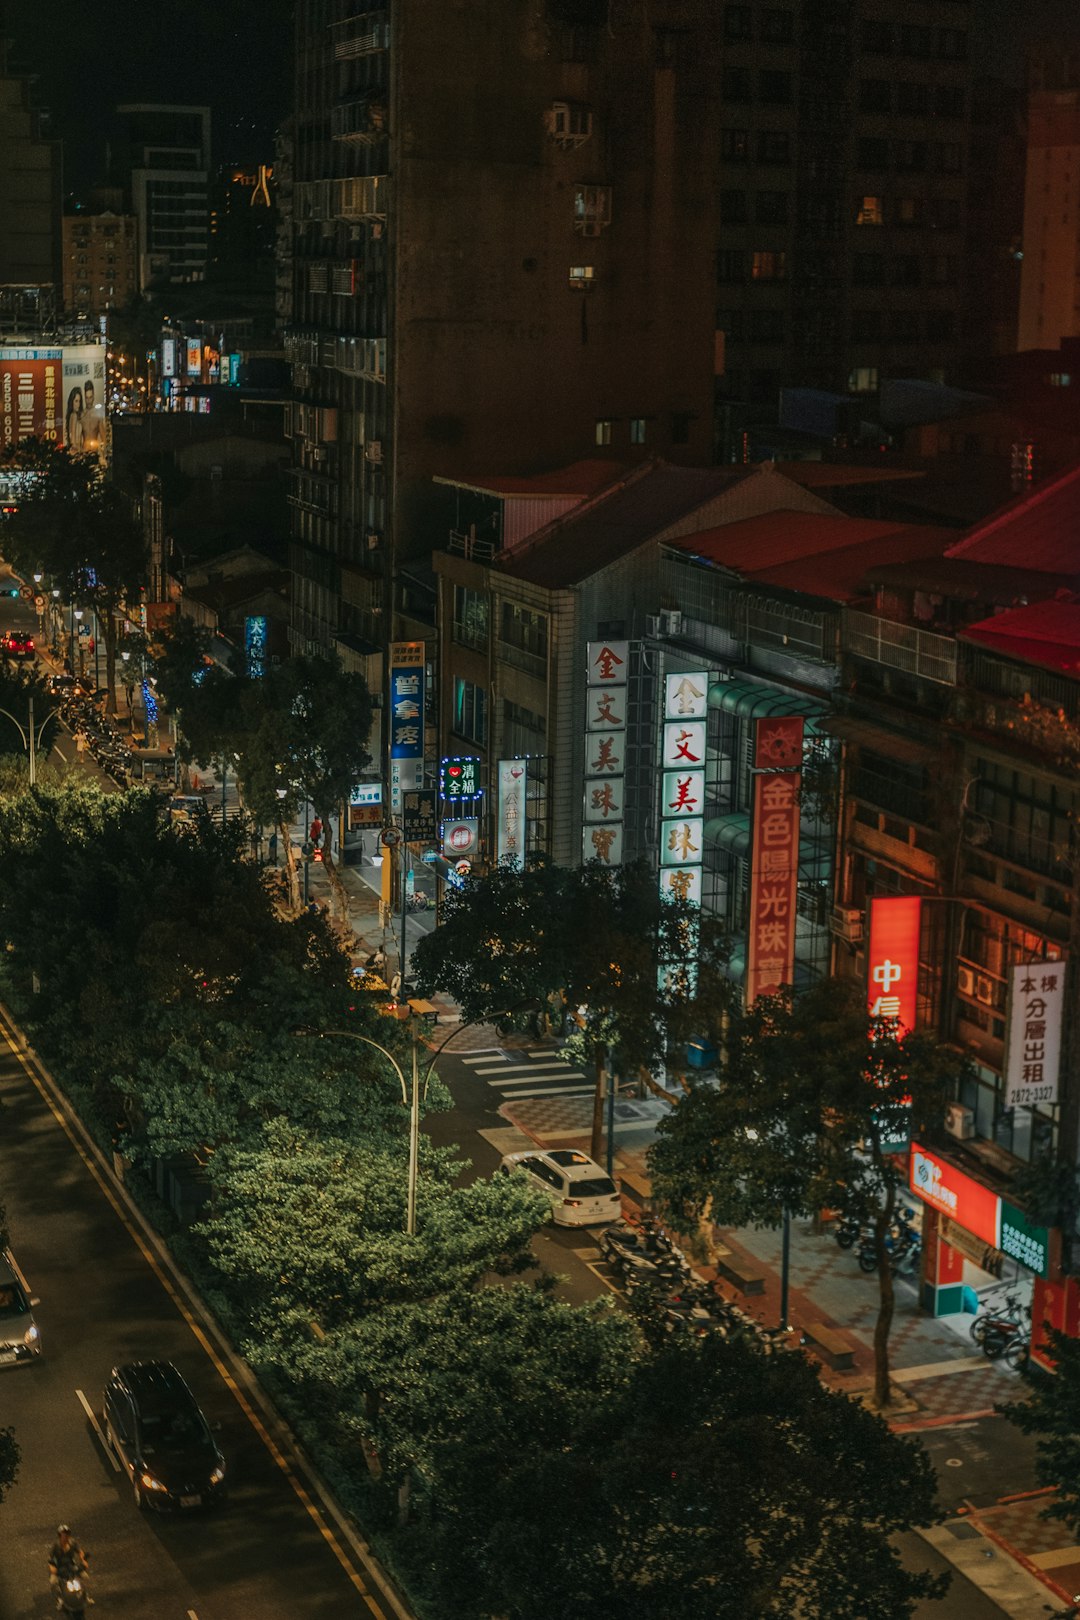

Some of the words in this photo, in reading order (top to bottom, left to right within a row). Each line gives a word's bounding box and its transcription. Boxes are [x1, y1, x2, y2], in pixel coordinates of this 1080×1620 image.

[394, 674, 420, 746] 普拿疼
[590, 647, 624, 865] 金文美珠寶
[757, 777, 794, 988] 金色陽光珠寶
[1019, 974, 1058, 994] 本棟
[1022, 998, 1047, 1084] 分層出租
